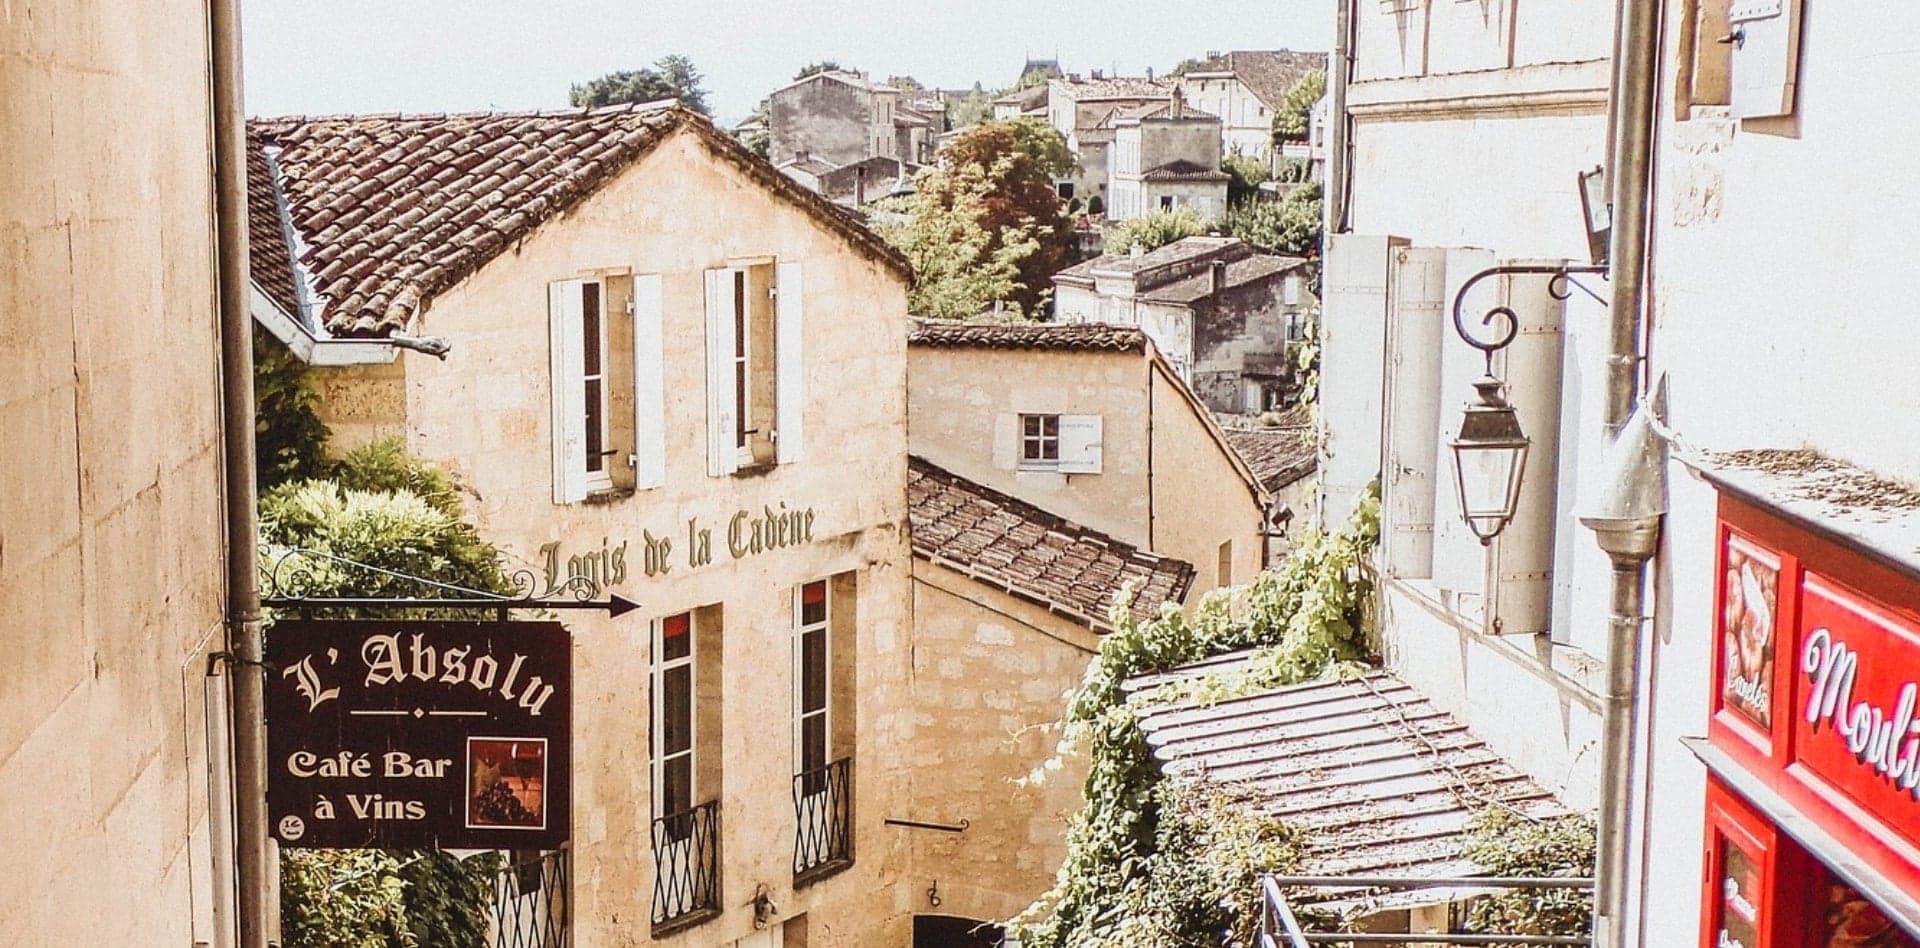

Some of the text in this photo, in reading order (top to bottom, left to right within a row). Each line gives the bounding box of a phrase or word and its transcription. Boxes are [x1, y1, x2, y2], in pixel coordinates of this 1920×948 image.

[540, 501, 815, 599] Logis de la Cadène
[1802, 627, 1920, 795] Mouli
[287, 751, 452, 778] Café Bar
[314, 794, 426, 820] à Vins
